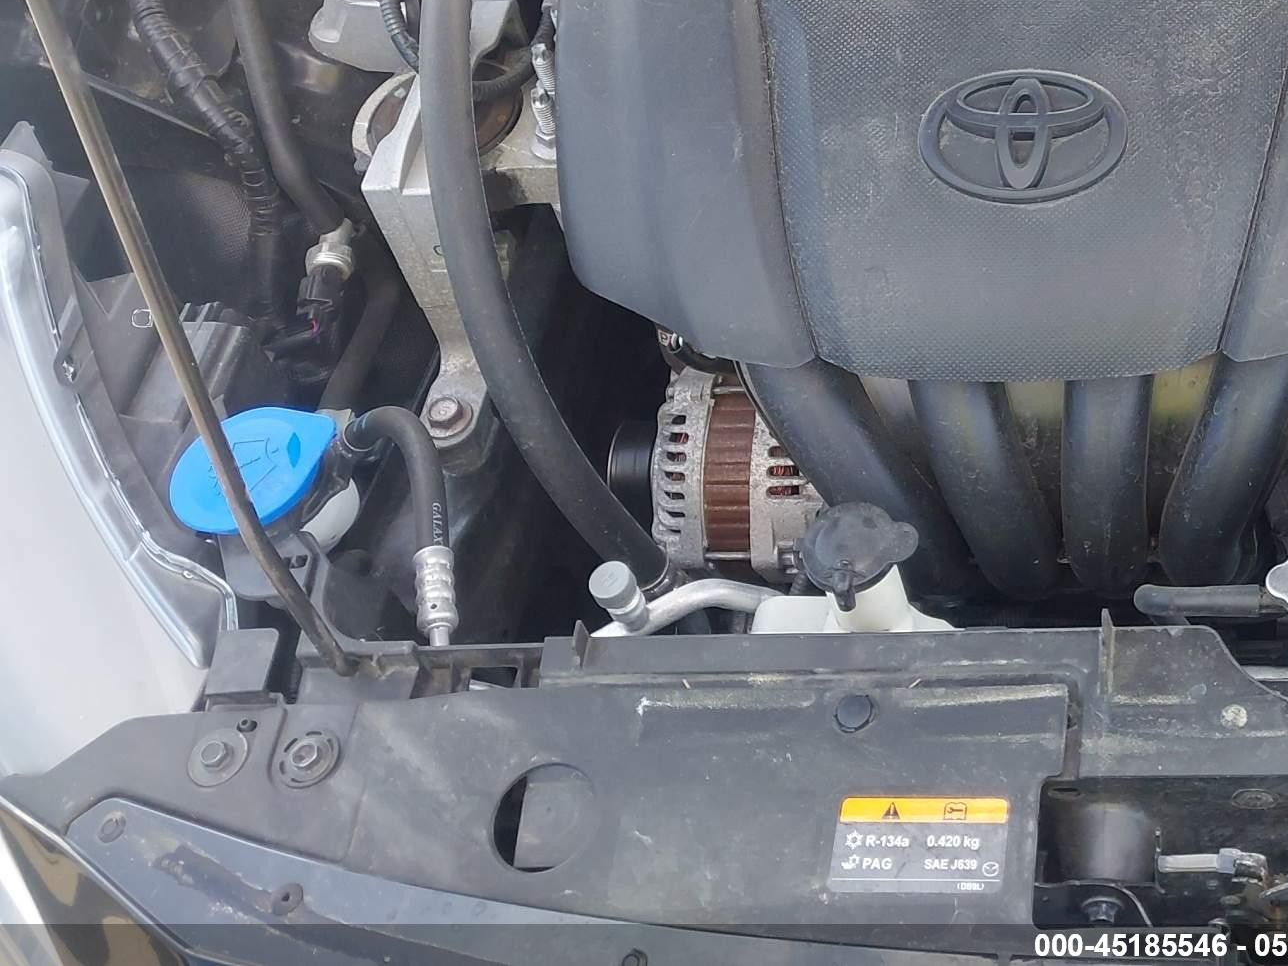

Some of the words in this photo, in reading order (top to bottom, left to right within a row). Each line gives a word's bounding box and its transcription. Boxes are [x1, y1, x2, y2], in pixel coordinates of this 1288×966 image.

[865, 835, 910, 848] R-134a
[926, 835, 961, 848] 0.420
[963, 835, 980, 850] kg
[862, 857, 892, 870] PAG
[924, 859, 948, 870] SAE
[950, 859, 978, 870] J639
